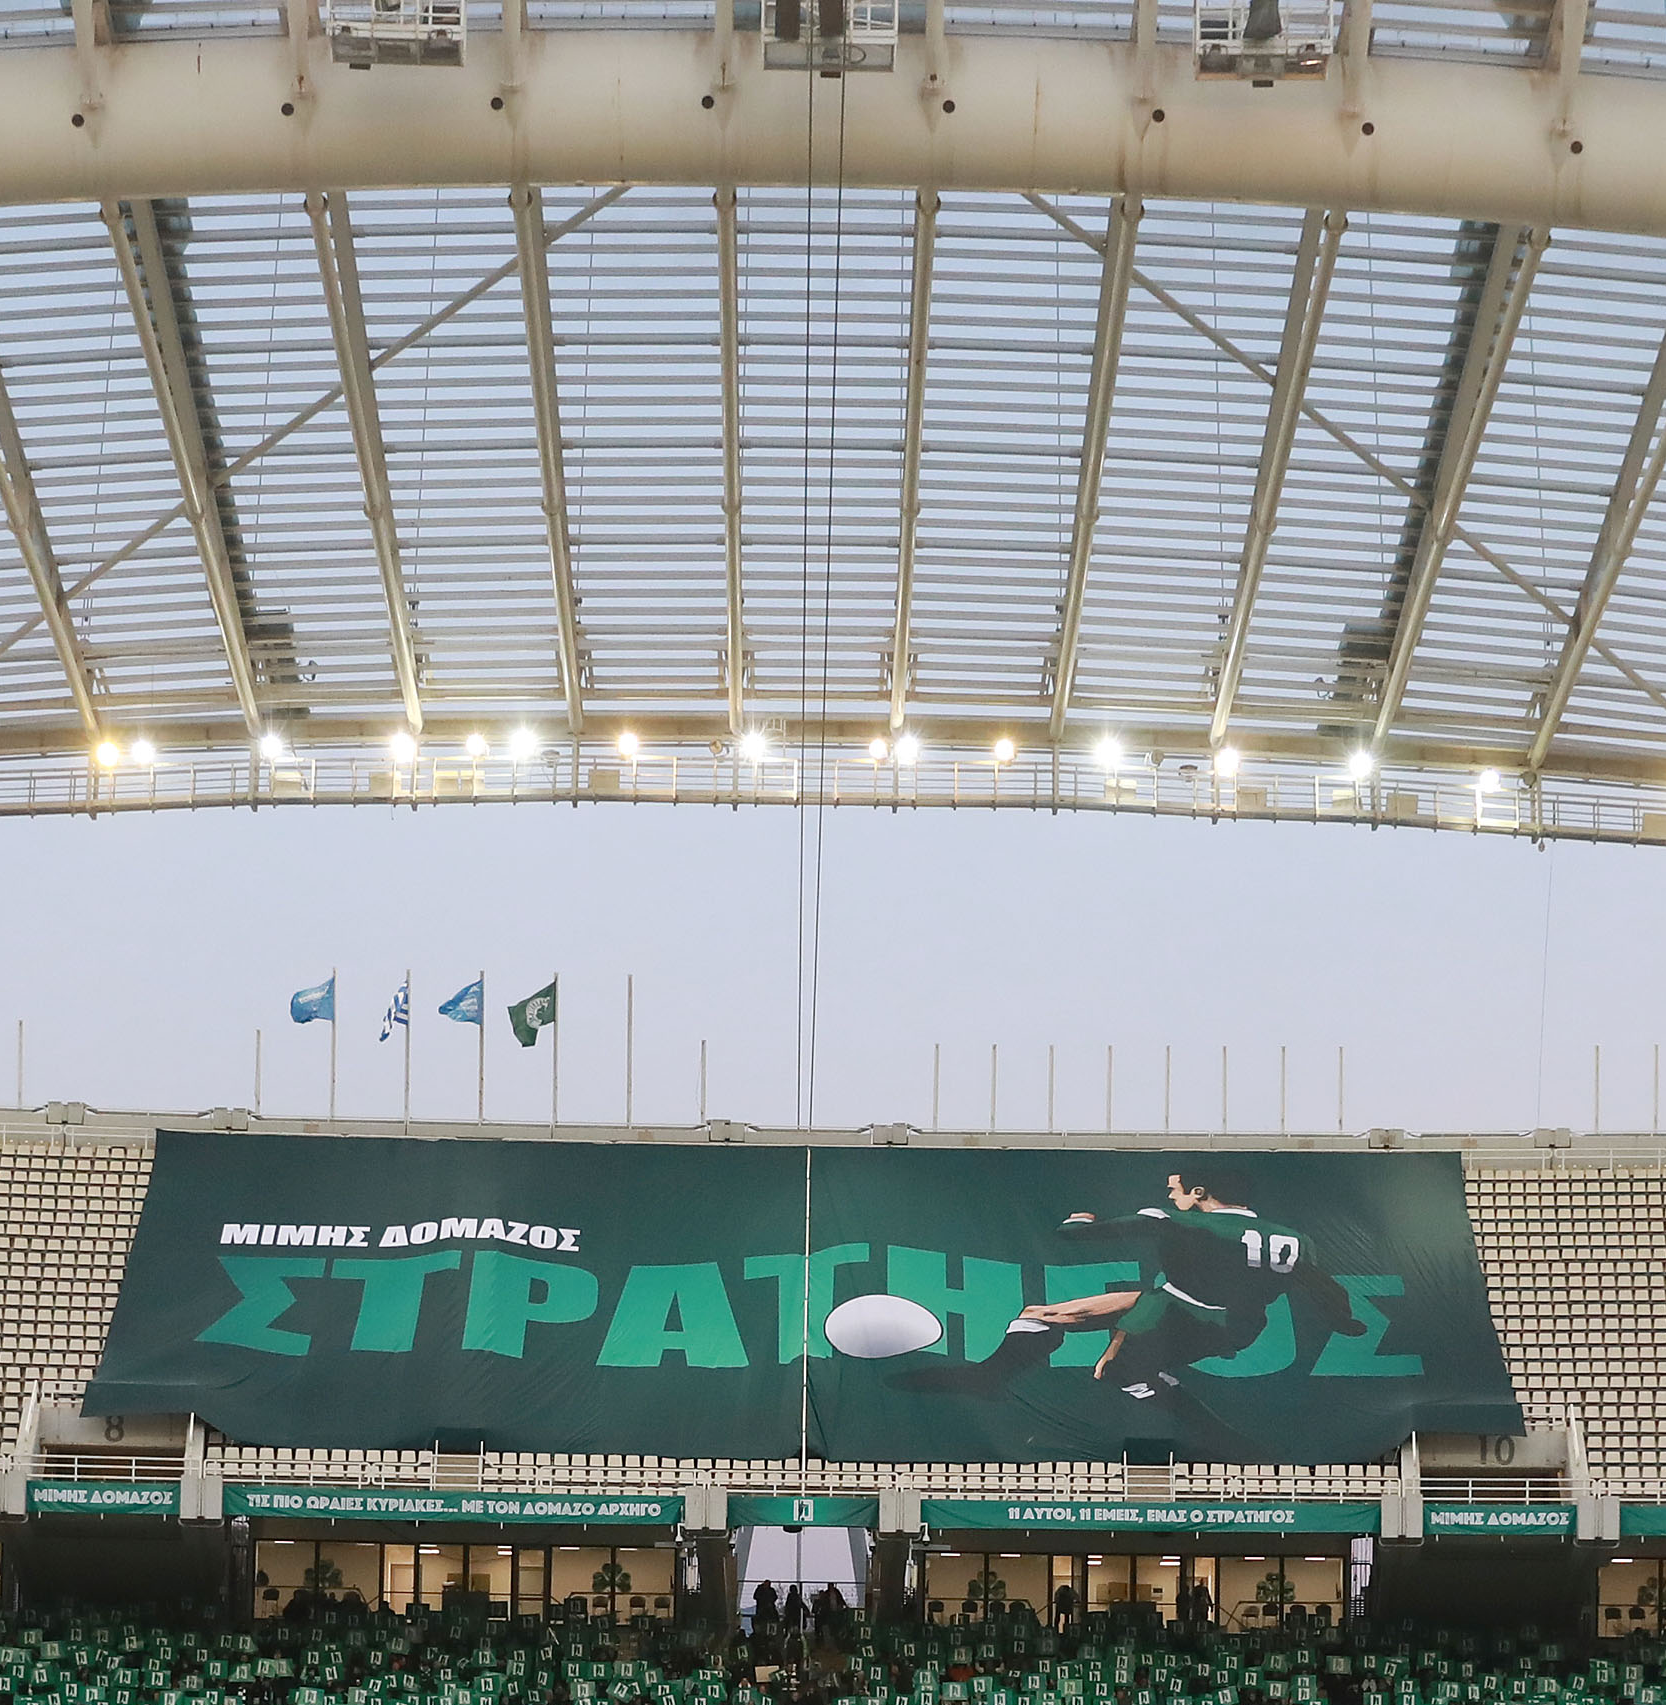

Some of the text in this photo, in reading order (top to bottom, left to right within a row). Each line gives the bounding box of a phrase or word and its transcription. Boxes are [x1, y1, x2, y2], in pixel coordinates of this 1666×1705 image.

[220, 1217, 581, 1252] ΜΙΜΗΣ ΔΟΜΑΖΟΣ
[1241, 1229, 1300, 1273] 10
[103, 1415, 125, 1443] 8
[1478, 1433, 1515, 1466] 10
[34, 1489, 173, 1505] ΜΙΜΗΣ ΔΟΜΑΖΟΣ
[247, 1494, 270, 1508] ΤΙΣ
[273, 1495, 303, 1509] ΠΙΟ
[306, 1496, 363, 1511] ΩΡΑΙΕΣ
[462, 1499, 483, 1514] ΜΕ
[487, 1501, 520, 1514] ΤΟΝ
[523, 1502, 595, 1516] ΔΟΜΑΖΟ
[597, 1503, 661, 1517] ΑΡΧΗΓΟ
[1147, 1509, 1187, 1523] ΕΝΑΣ
[1190, 1510, 1203, 1523] Ο
[1206, 1509, 1294, 1524] ΣΤΡΑΤΗΓΟΣ
[1431, 1511, 1569, 1526] ΜΙΜΗΣ ΔΟΜΑΖΟΣ
